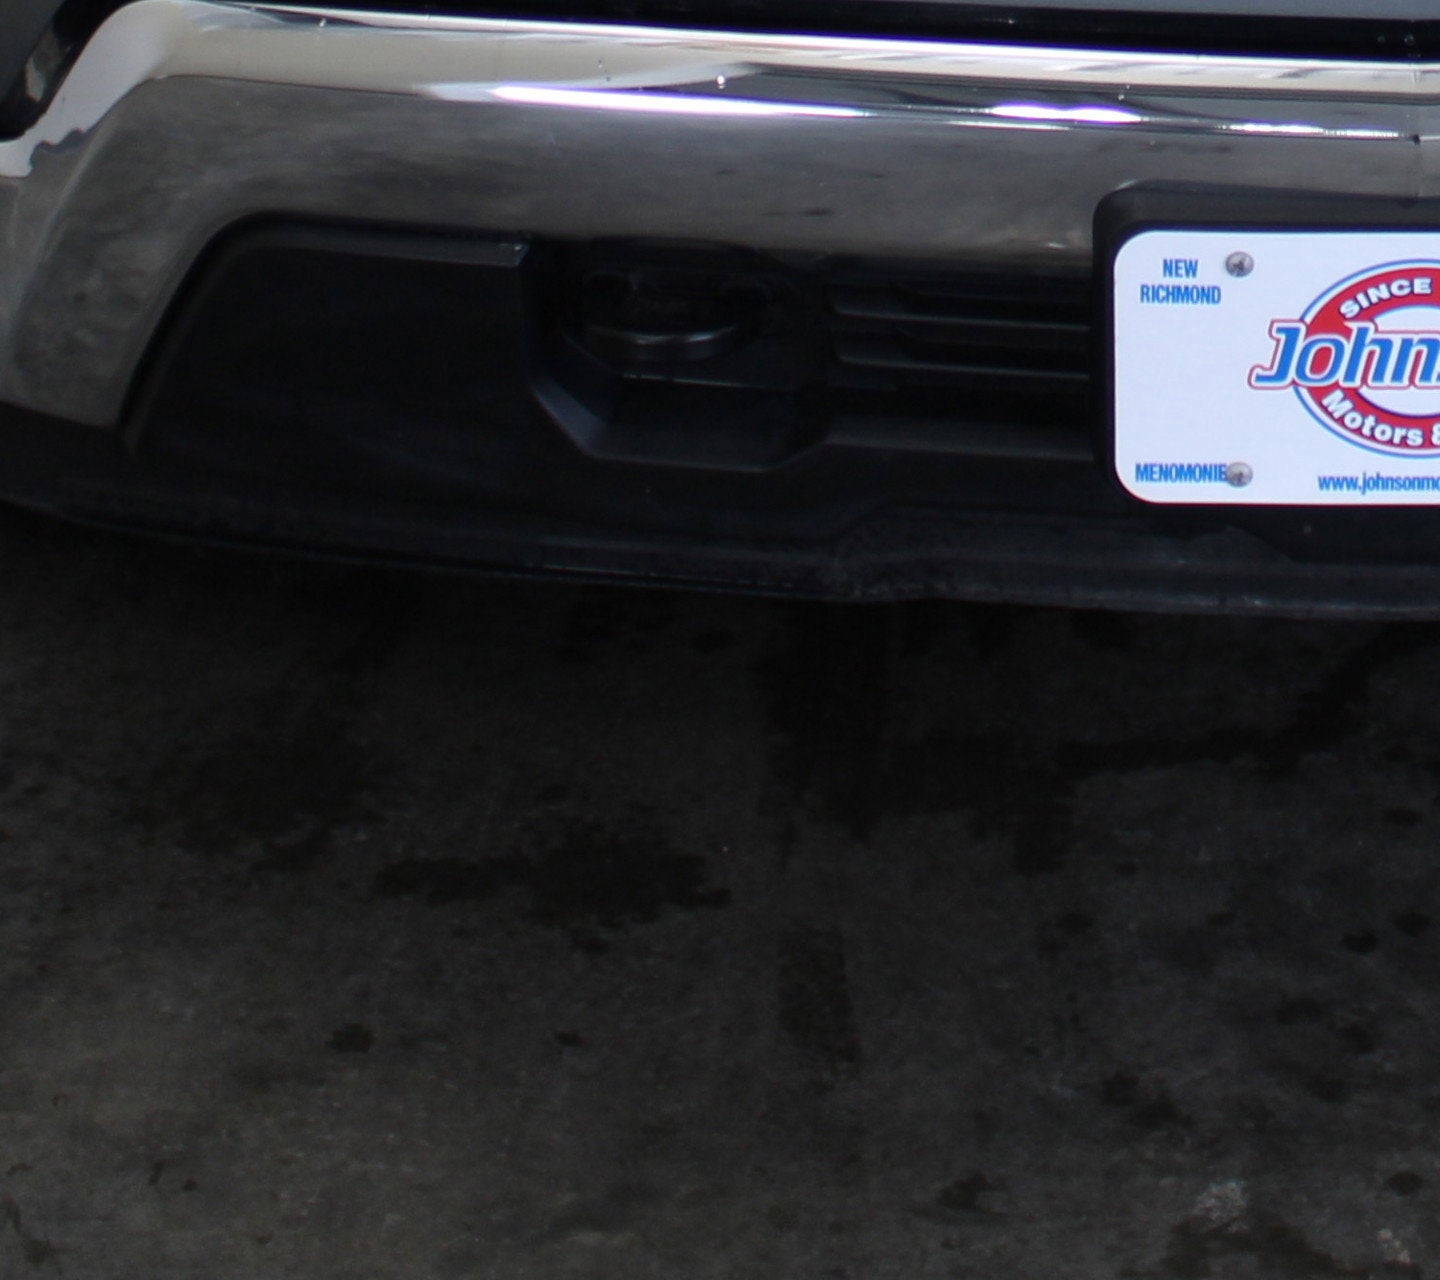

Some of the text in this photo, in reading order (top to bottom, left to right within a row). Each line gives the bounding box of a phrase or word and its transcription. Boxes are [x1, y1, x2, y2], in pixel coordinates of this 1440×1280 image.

[1162, 258, 1198, 278] NEW
[1140, 285, 1221, 305] RICHMOND
[1339, 277, 1432, 319] SINCE
[1321, 389, 1423, 446] Motors
[1135, 463, 1227, 482] MENOMONIE
